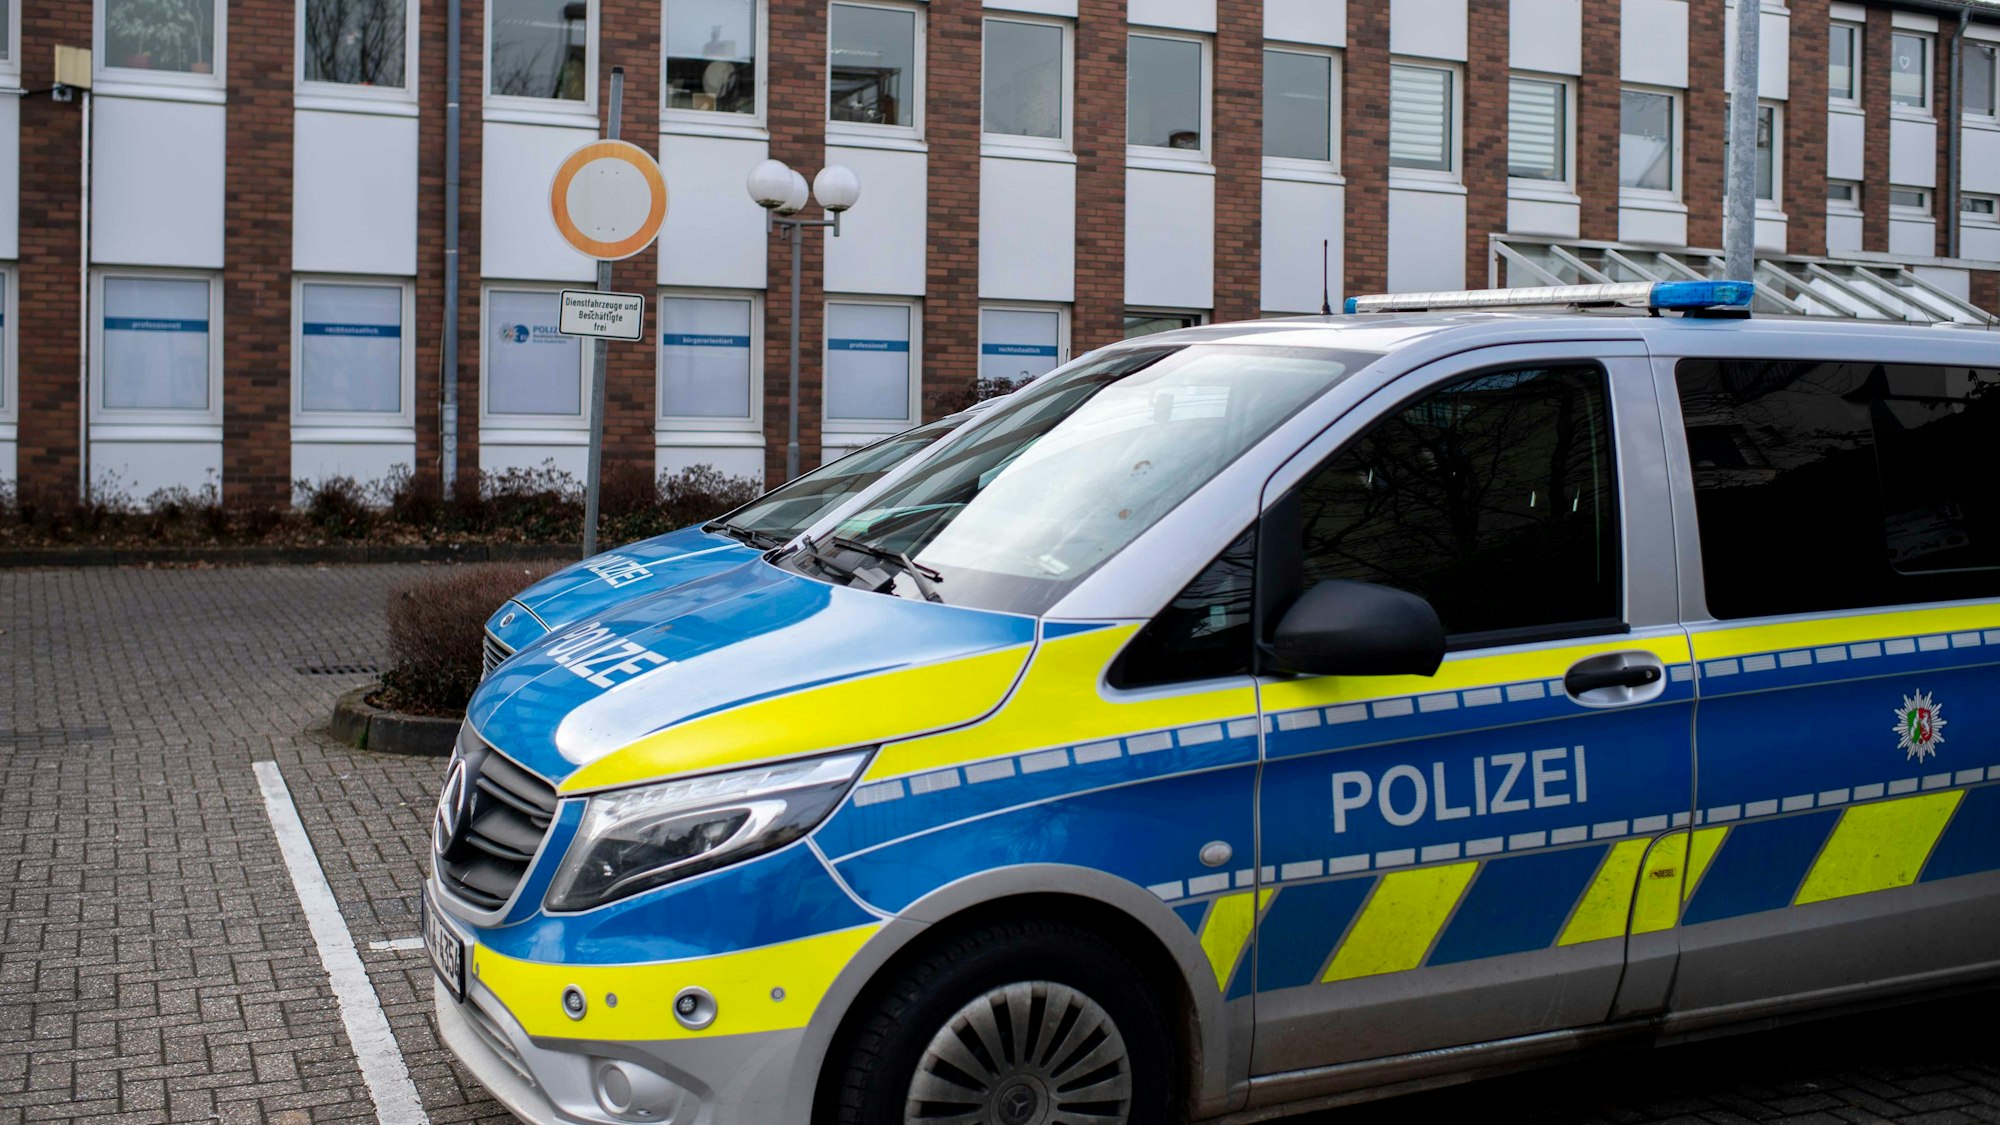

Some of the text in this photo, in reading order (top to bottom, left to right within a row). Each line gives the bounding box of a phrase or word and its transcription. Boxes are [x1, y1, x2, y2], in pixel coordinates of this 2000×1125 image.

[565, 297, 638, 311] Dienstfahrzeuge und
[578, 310, 623, 323] Beschäftigte
[533, 325, 558, 334] POLIZ
[593, 322, 607, 331] frei
[849, 342, 888, 350] professionell
[1331, 745, 1588, 834] POLIZEI
